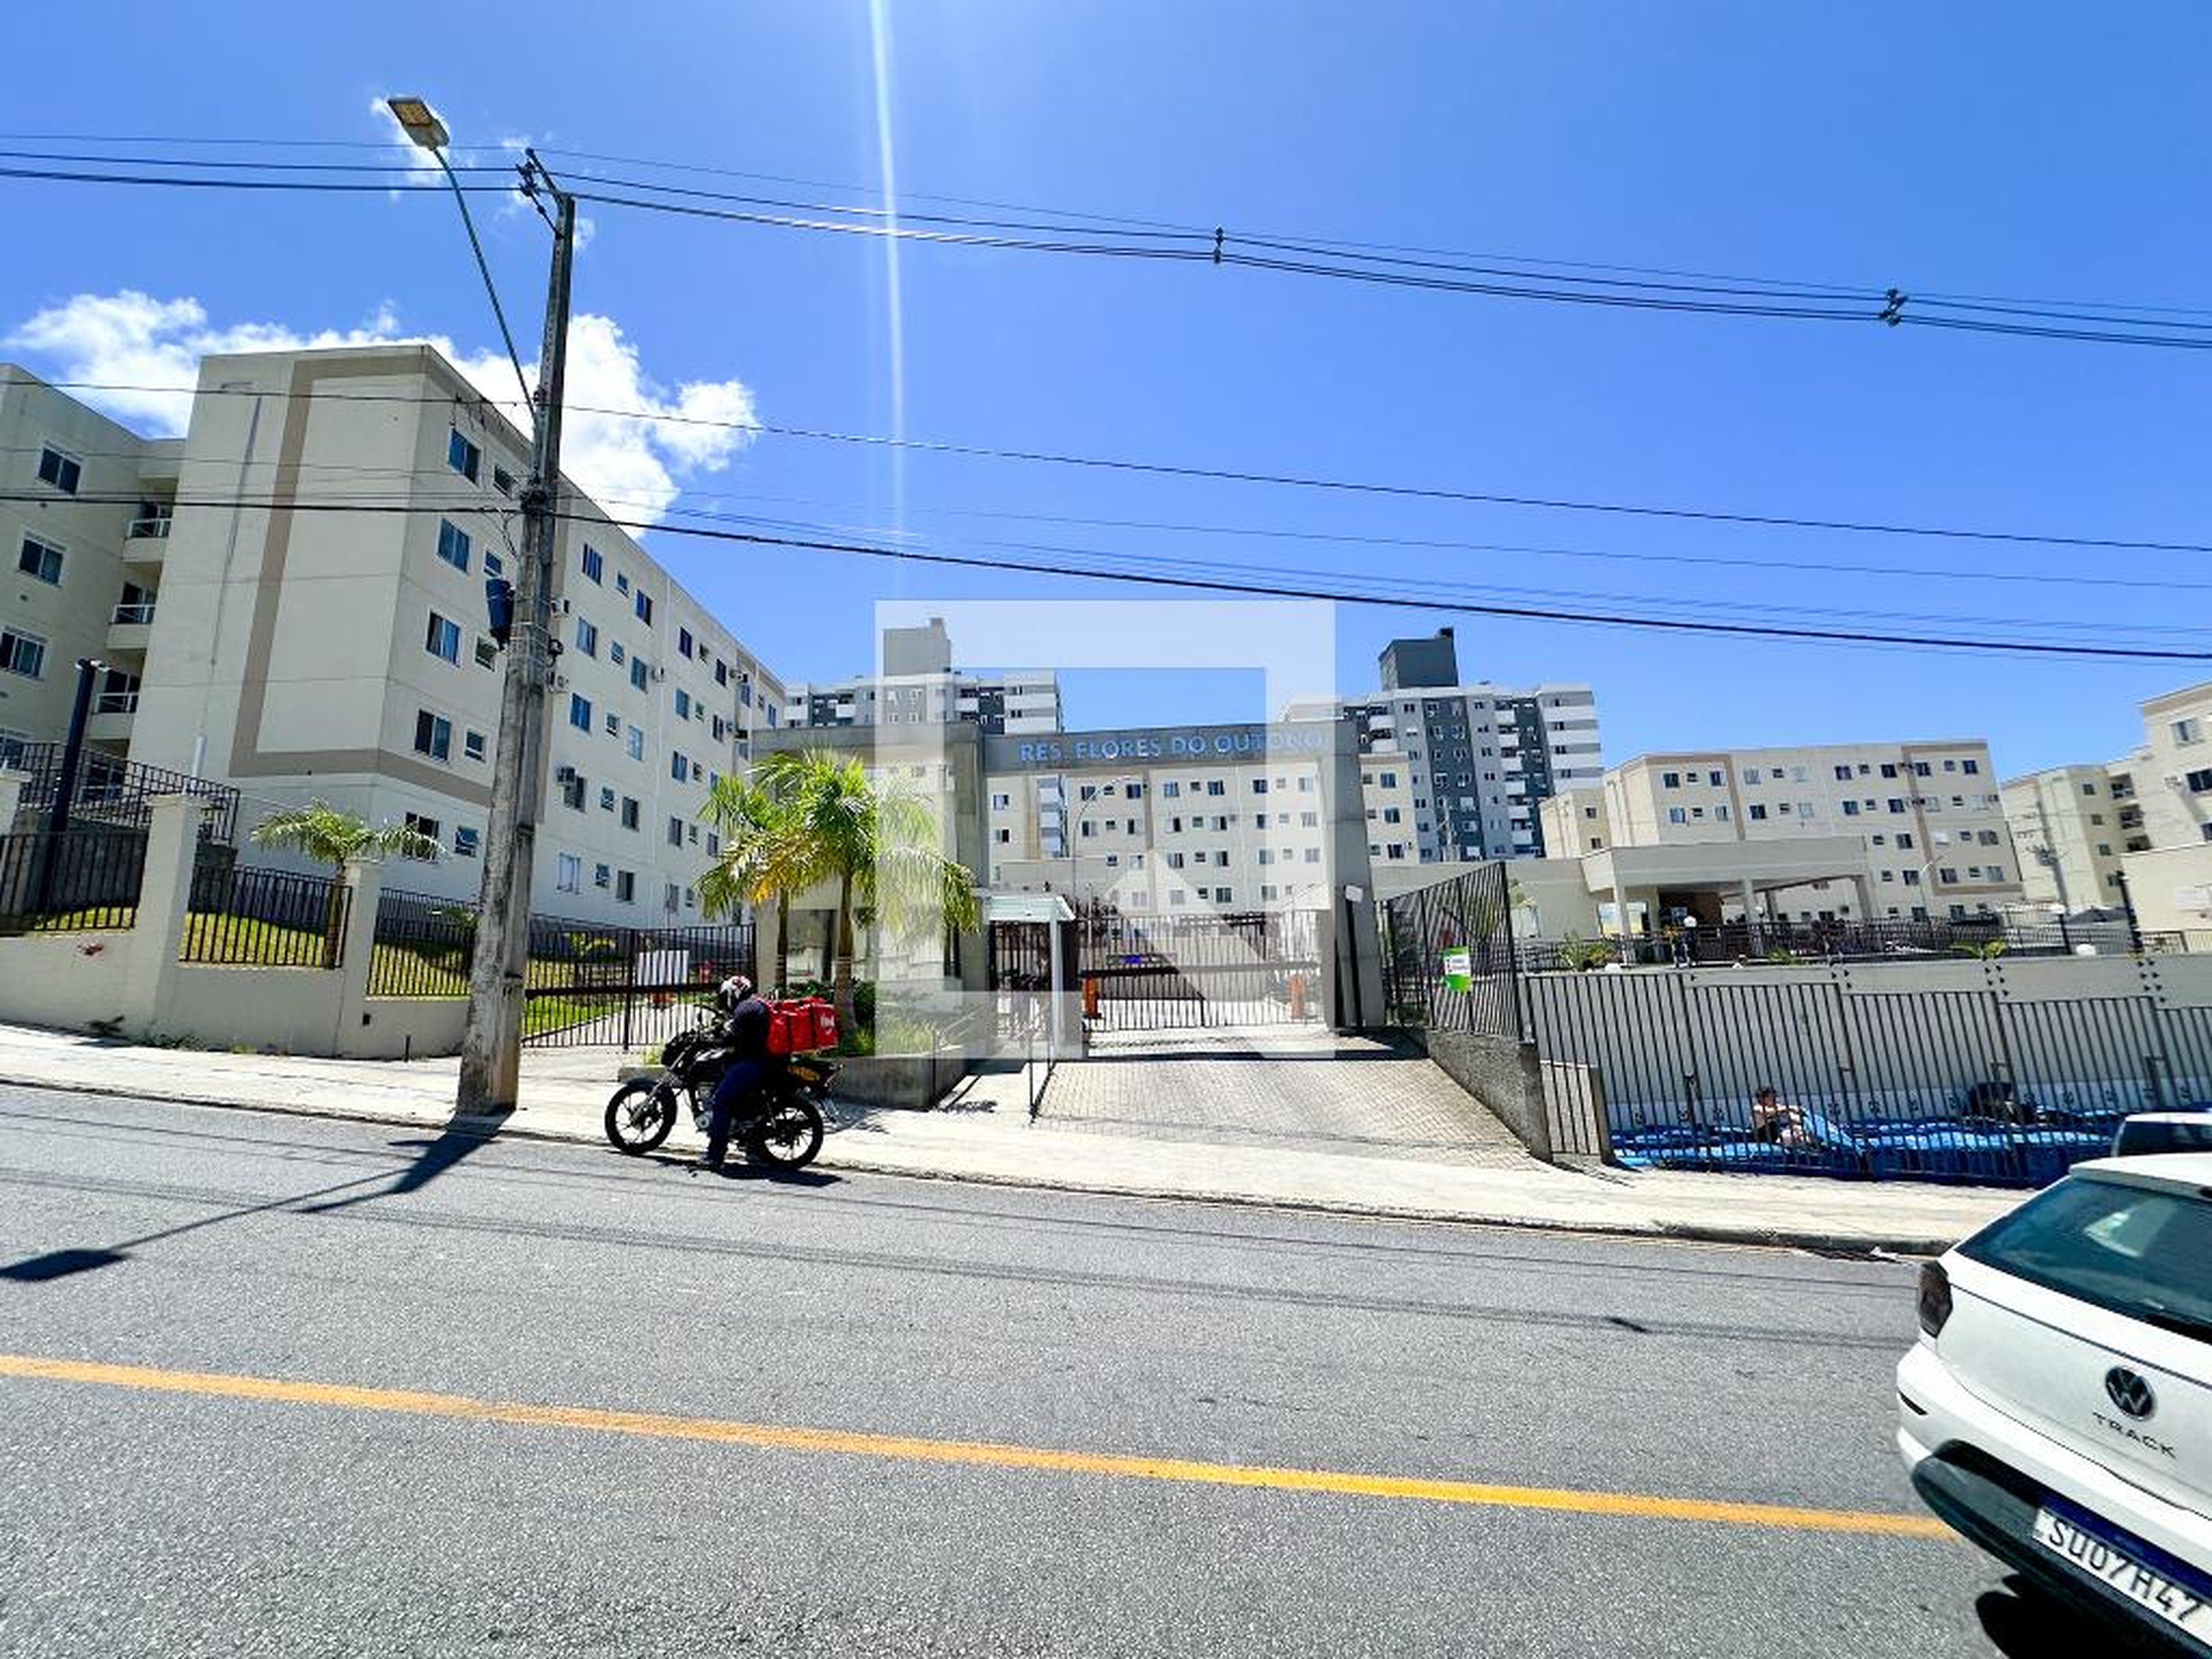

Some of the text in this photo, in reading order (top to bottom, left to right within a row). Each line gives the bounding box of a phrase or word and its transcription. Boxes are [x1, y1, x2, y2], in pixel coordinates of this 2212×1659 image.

[1075, 737, 1161, 759] FLORES
[1172, 736, 1206, 754] DO
[2092, 1411, 2176, 1460] TRACK
